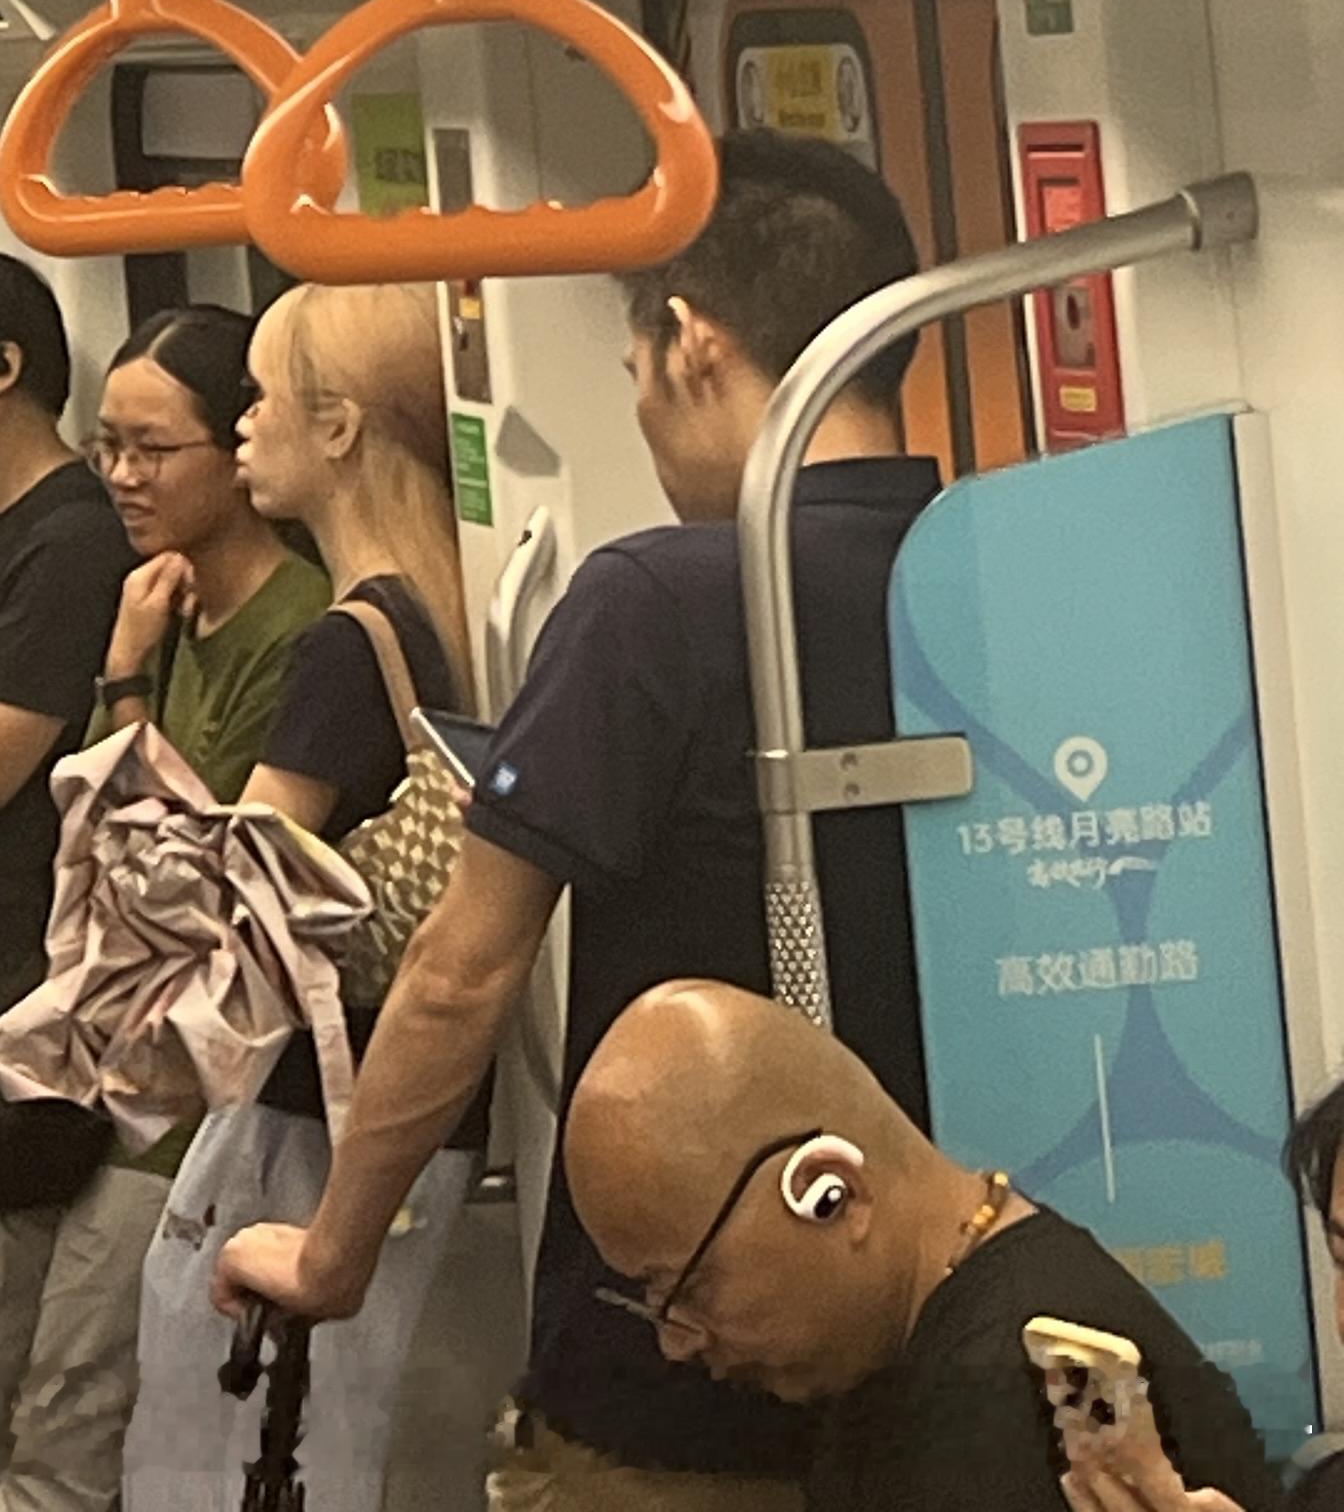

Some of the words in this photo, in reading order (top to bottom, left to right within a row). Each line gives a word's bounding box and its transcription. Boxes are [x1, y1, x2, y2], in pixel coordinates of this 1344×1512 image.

[956, 800, 1211, 856] 13号线月亮路站
